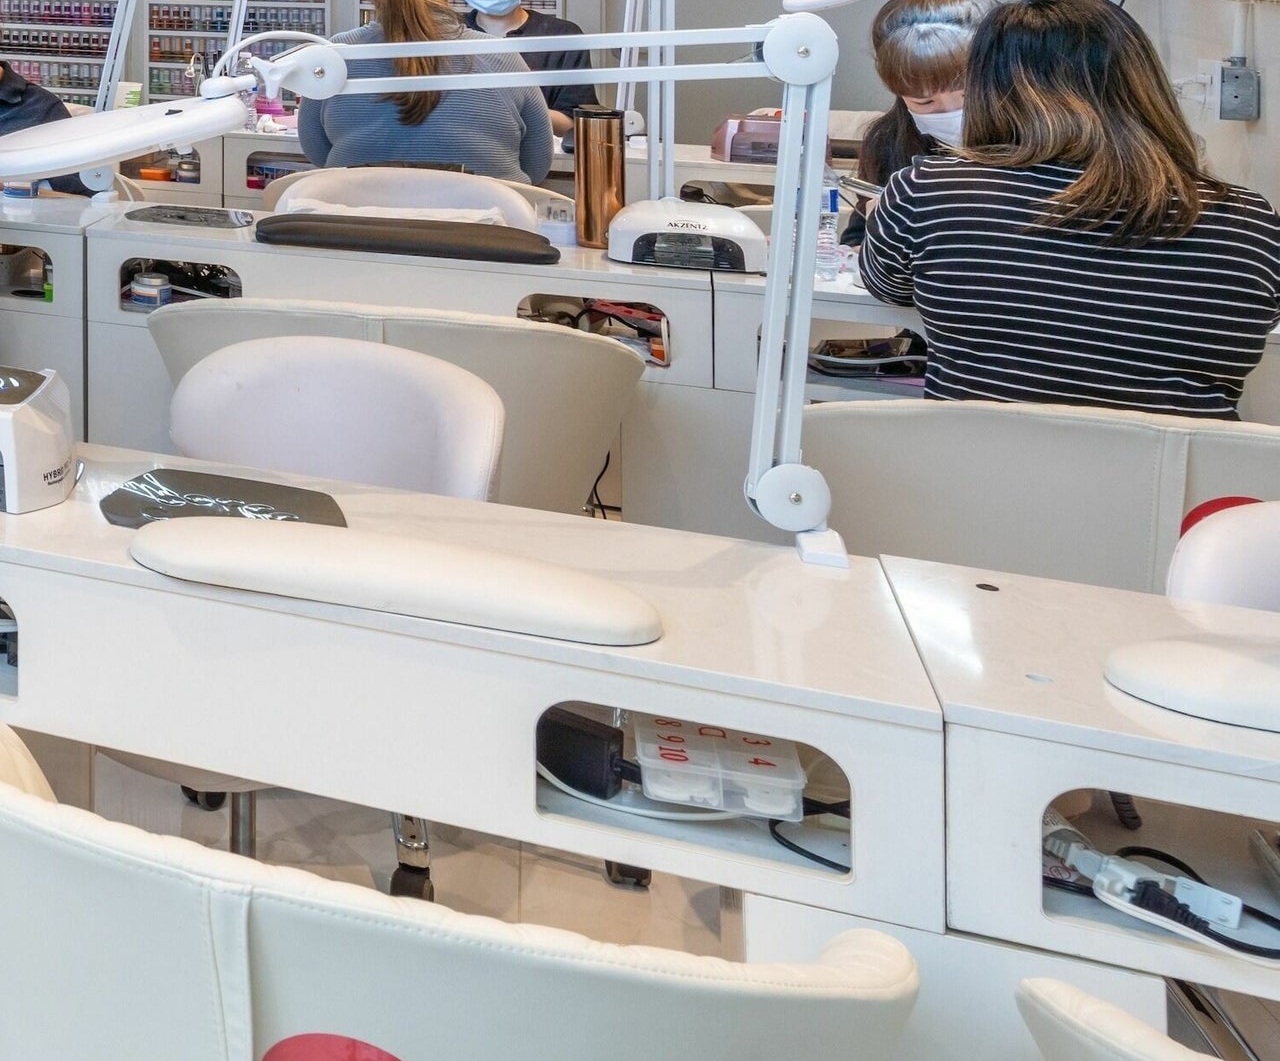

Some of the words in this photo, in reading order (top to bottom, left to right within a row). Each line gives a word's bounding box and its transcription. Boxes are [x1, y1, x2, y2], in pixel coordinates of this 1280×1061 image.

[667, 222, 709, 230] AKZENTZ
[657, 734, 685, 743] 9
[658, 746, 689, 762] 10
